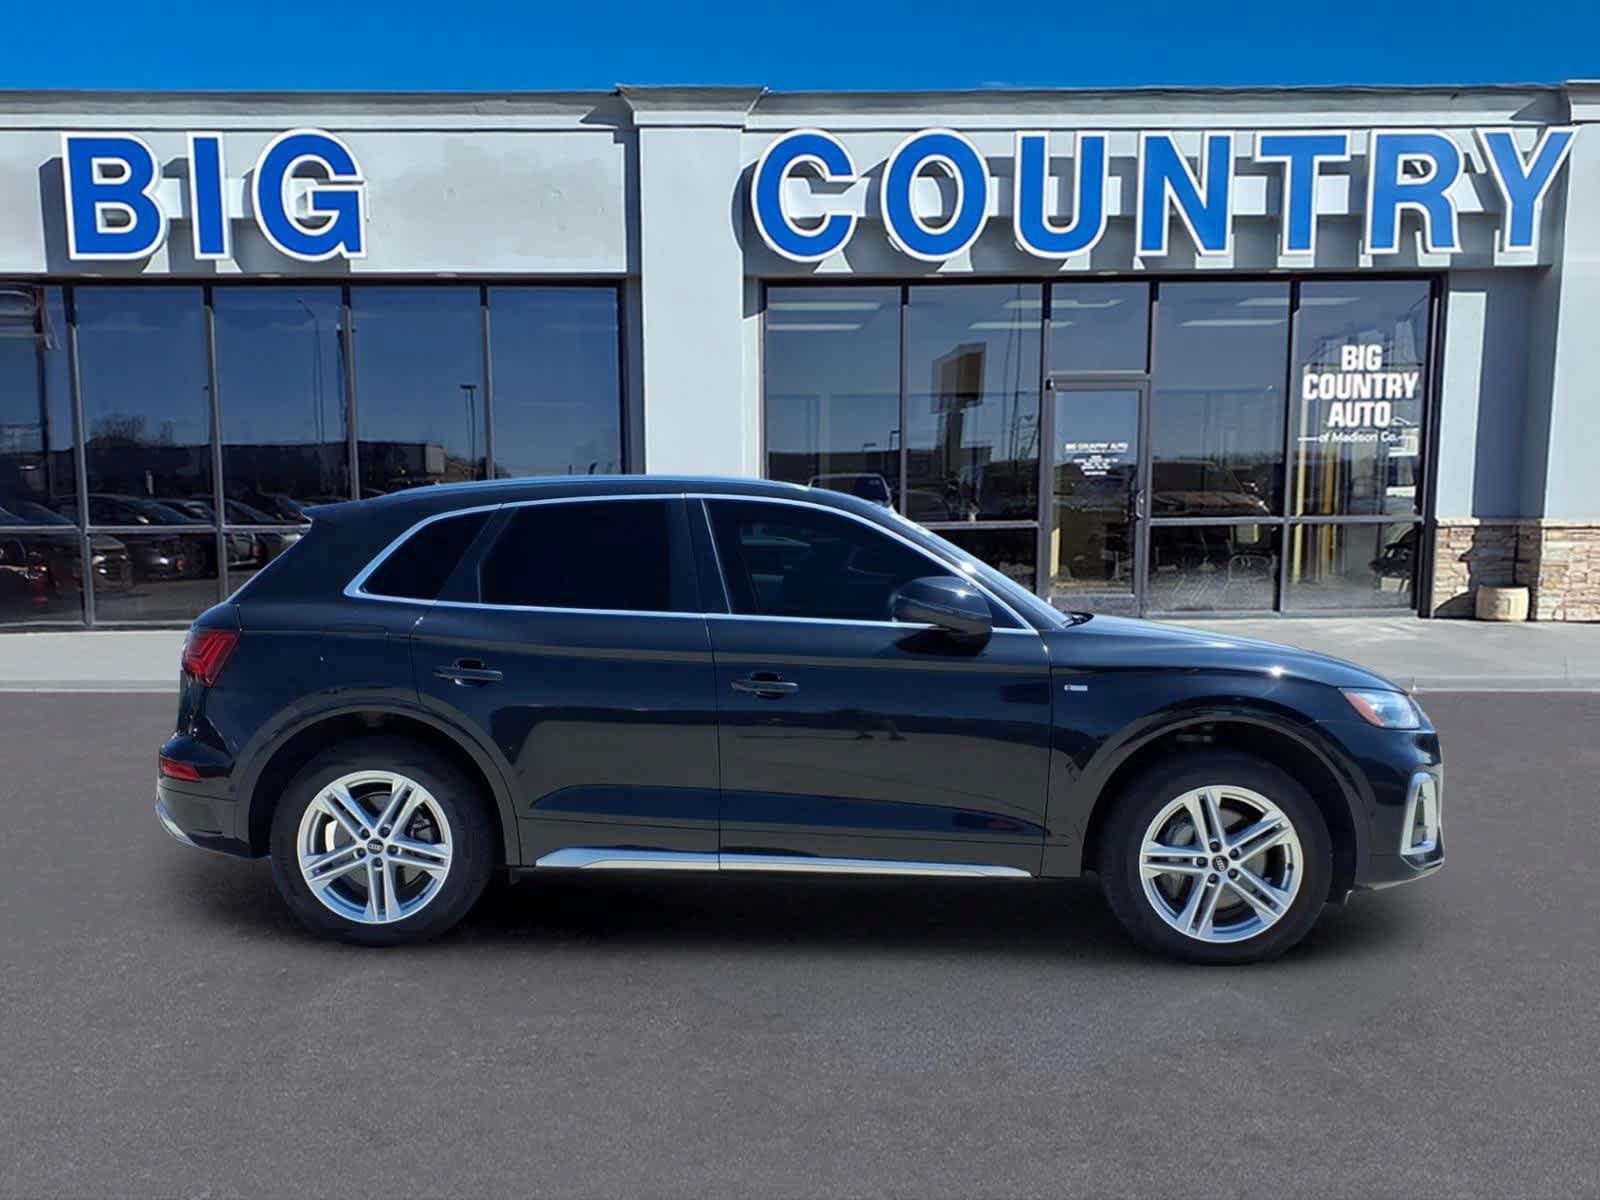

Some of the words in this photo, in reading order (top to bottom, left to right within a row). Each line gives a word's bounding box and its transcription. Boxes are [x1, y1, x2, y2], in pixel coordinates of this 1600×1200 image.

[62, 129, 367, 261] BIG
[751, 127, 1577, 261] COUNTRY
[1341, 344, 1382, 371] BIG
[1302, 372, 1419, 400] COUNTRY
[1328, 401, 1391, 428] AUTO
[1319, 432, 1330, 443] of
[1331, 431, 1378, 442] Madison
